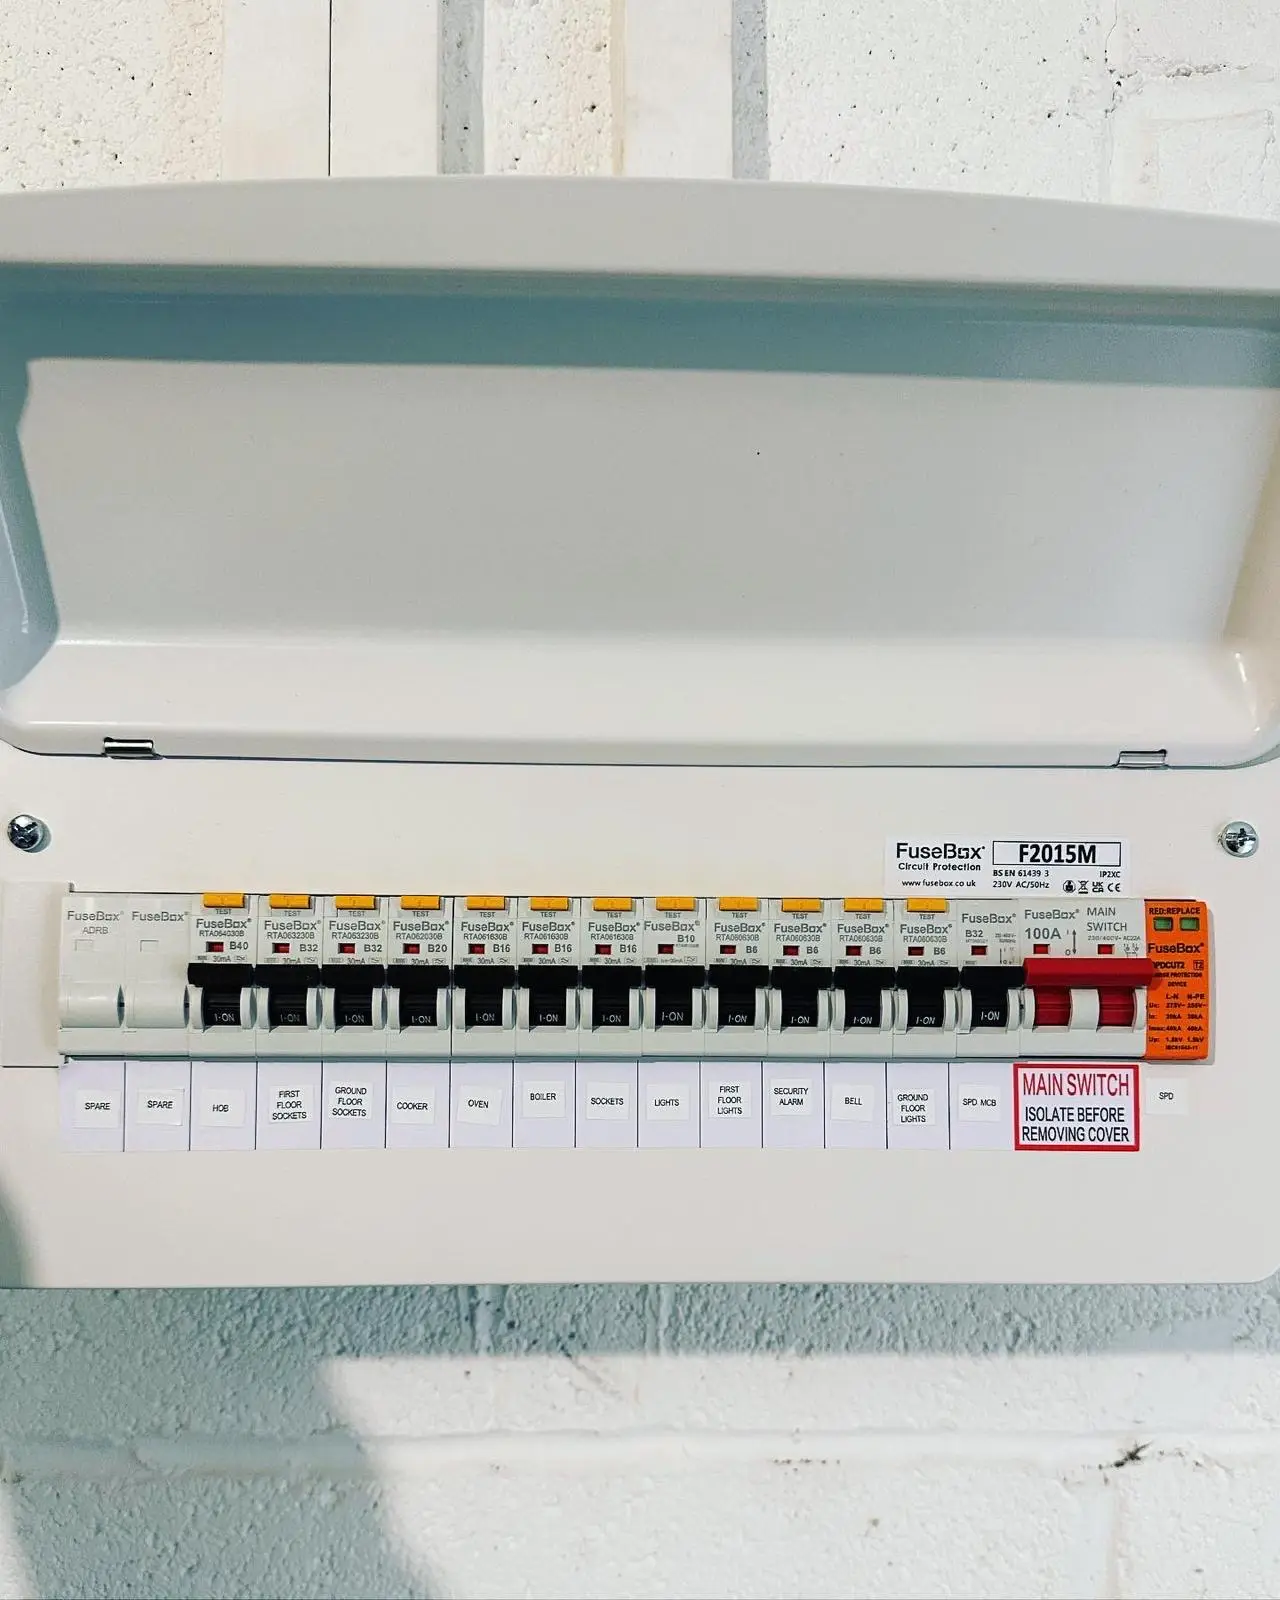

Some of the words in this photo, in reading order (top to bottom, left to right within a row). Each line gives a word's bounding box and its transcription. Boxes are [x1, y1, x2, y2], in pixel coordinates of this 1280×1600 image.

[896, 842, 982, 859] FuseBox
[1019, 844, 1096, 863] F2015M
[898, 862, 929, 871] Circuit
[933, 862, 981, 871] Protection
[993, 869, 1003, 877] BS
[1004, 869, 1015, 877] EN
[1100, 870, 1121, 878] IP2XC
[992, 880, 1013, 888] 230V
[67, 910, 120, 921] FuseBox
[131, 911, 184, 921] FuseBox
[1024, 909, 1076, 920] FuseBox
[1086, 907, 1116, 916] MAIN
[962, 913, 1013, 924] FuseBox
[196, 918, 247, 929] FuseBox
[264, 920, 317, 931] FuseBox
[329, 921, 381, 931] FuseBox
[393, 921, 445, 931] FuseBox
[461, 922, 510, 932] FuseBox
[522, 922, 571, 932] FuseBox
[588, 922, 637, 932] FuseBox
[644, 921, 695, 931] FuseBox
[714, 922, 762, 933] FuseBox
[774, 923, 823, 933] FuseBox
[1086, 922, 1127, 932] SWITCH
[837, 924, 885, 934] FuseBox
[900, 924, 949, 934] FuseBox
[677, 934, 695, 943] B10
[965, 930, 984, 938] B32
[1025, 928, 1062, 940] 100A
[229, 941, 249, 950] B40
[299, 944, 319, 952] B32
[363, 944, 383, 953] B32
[427, 944, 448, 953] B20
[493, 944, 511, 953] B16
[554, 944, 572, 953] B16
[619, 944, 637, 953] B16
[746, 946, 758, 954] B6
[806, 946, 819, 954] B6
[1147, 943, 1201, 954] FuseBox
[869, 947, 882, 955] B6
[933, 947, 946, 955] B6
[719, 1085, 740, 1094] FIRST
[1023, 1073, 1063, 1096] MAIN
[1067, 1073, 1129, 1097] SWITCH
[278, 1090, 301, 1098] FIRST
[335, 1086, 367, 1095] GROUND
[773, 1087, 808, 1096] SECURITY
[530, 1092, 556, 1101] BOILER
[717, 1096, 742, 1104] FLOOR
[897, 1093, 929, 1102] GROUND
[1159, 1091, 1174, 1100] SPD
[147, 1100, 173, 1109] SPARE
[276, 1101, 302, 1109] FLOOR
[337, 1097, 363, 1106] FLOOR
[396, 1101, 428, 1110] COOKER
[468, 1099, 489, 1109] OVEN
[590, 1097, 624, 1106] SOCKETS
[654, 1098, 680, 1107] LIGHTS
[778, 1098, 804, 1106] ALARM
[844, 1097, 863, 1106] BELL
[962, 1098, 978, 1107] SPD
[980, 1098, 997, 1107] MCB
[84, 1102, 111, 1111] SPARE
[212, 1104, 229, 1112] HOB
[717, 1106, 742, 1115] LIGHTS
[900, 1104, 926, 1112] FLOOR
[272, 1111, 307, 1120] SOCKETS
[332, 1108, 366, 1117] SOCKETS
[1025, 1106, 1074, 1122] ISOLATE
[1077, 1107, 1125, 1123] BEFORE
[900, 1115, 926, 1123] LIGHTS
[1022, 1126, 1085, 1142] REMOVING
[1088, 1126, 1130, 1142] COVER
